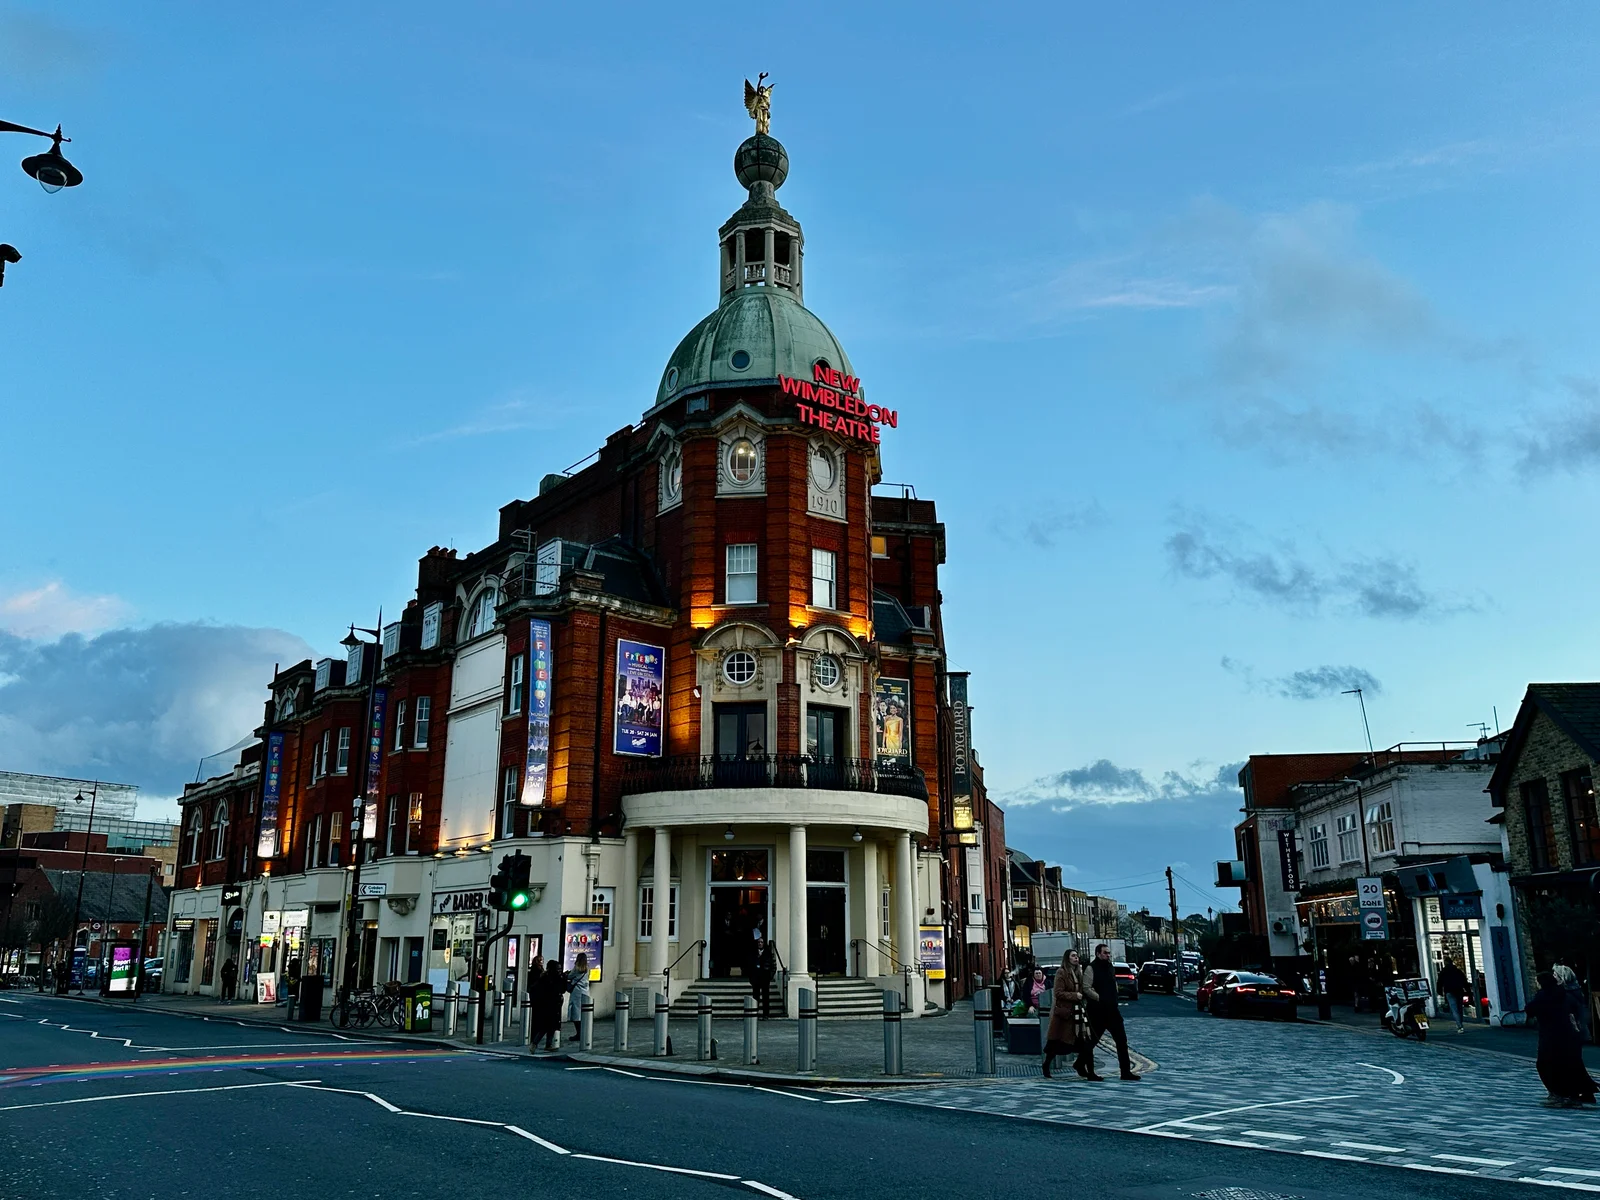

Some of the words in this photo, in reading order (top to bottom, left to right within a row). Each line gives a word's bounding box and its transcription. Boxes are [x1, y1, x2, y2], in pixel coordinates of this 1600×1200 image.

[814, 364, 860, 394] NEW
[778, 374, 897, 428] WIMBLEDON
[796, 403, 880, 444] THEATRE
[811, 495, 837, 514] 1910
[624, 651, 658, 664] FRIENDS
[371, 706, 381, 760] FRIENDS
[953, 700, 966, 775] BODYGUARD
[269, 746, 279, 793] FRIENDS
[1283, 832, 1295, 889] WETHERSPOON
[453, 892, 483, 911] BARBER
[1363, 885, 1378, 893] 20
[1449, 906, 1454, 914] 2
[567, 934, 600, 943] FRIENDS
